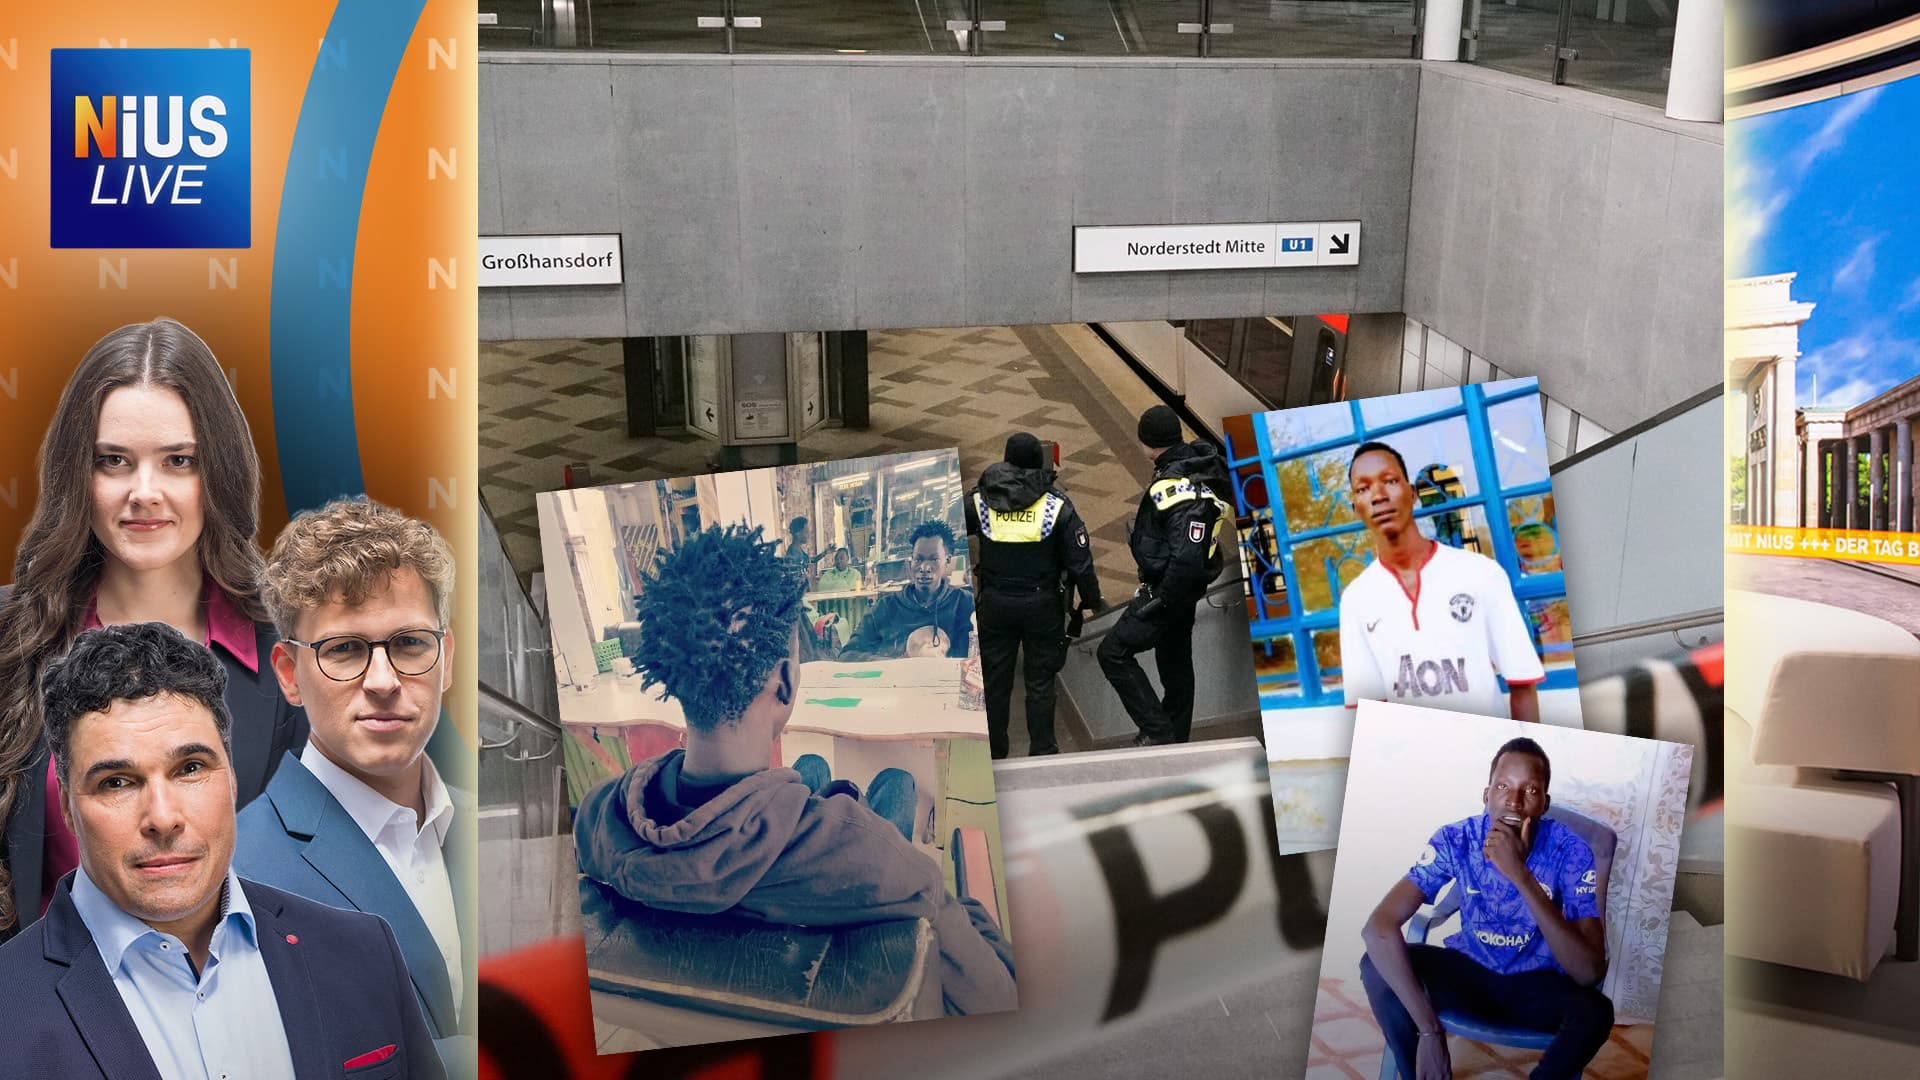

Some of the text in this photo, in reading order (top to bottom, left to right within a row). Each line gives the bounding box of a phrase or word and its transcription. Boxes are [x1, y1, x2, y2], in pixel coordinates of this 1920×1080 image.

[1127, 238, 1306, 256] Norderstedt Mitte U1
[482, 252, 613, 270] Großhansdorf
[995, 510, 1036, 523] POLIZEI
[1756, 533, 1795, 550] NIUS
[1835, 537, 1869, 555] DER
[1872, 539, 1904, 557] TAG
[1393, 653, 1469, 698] AON
